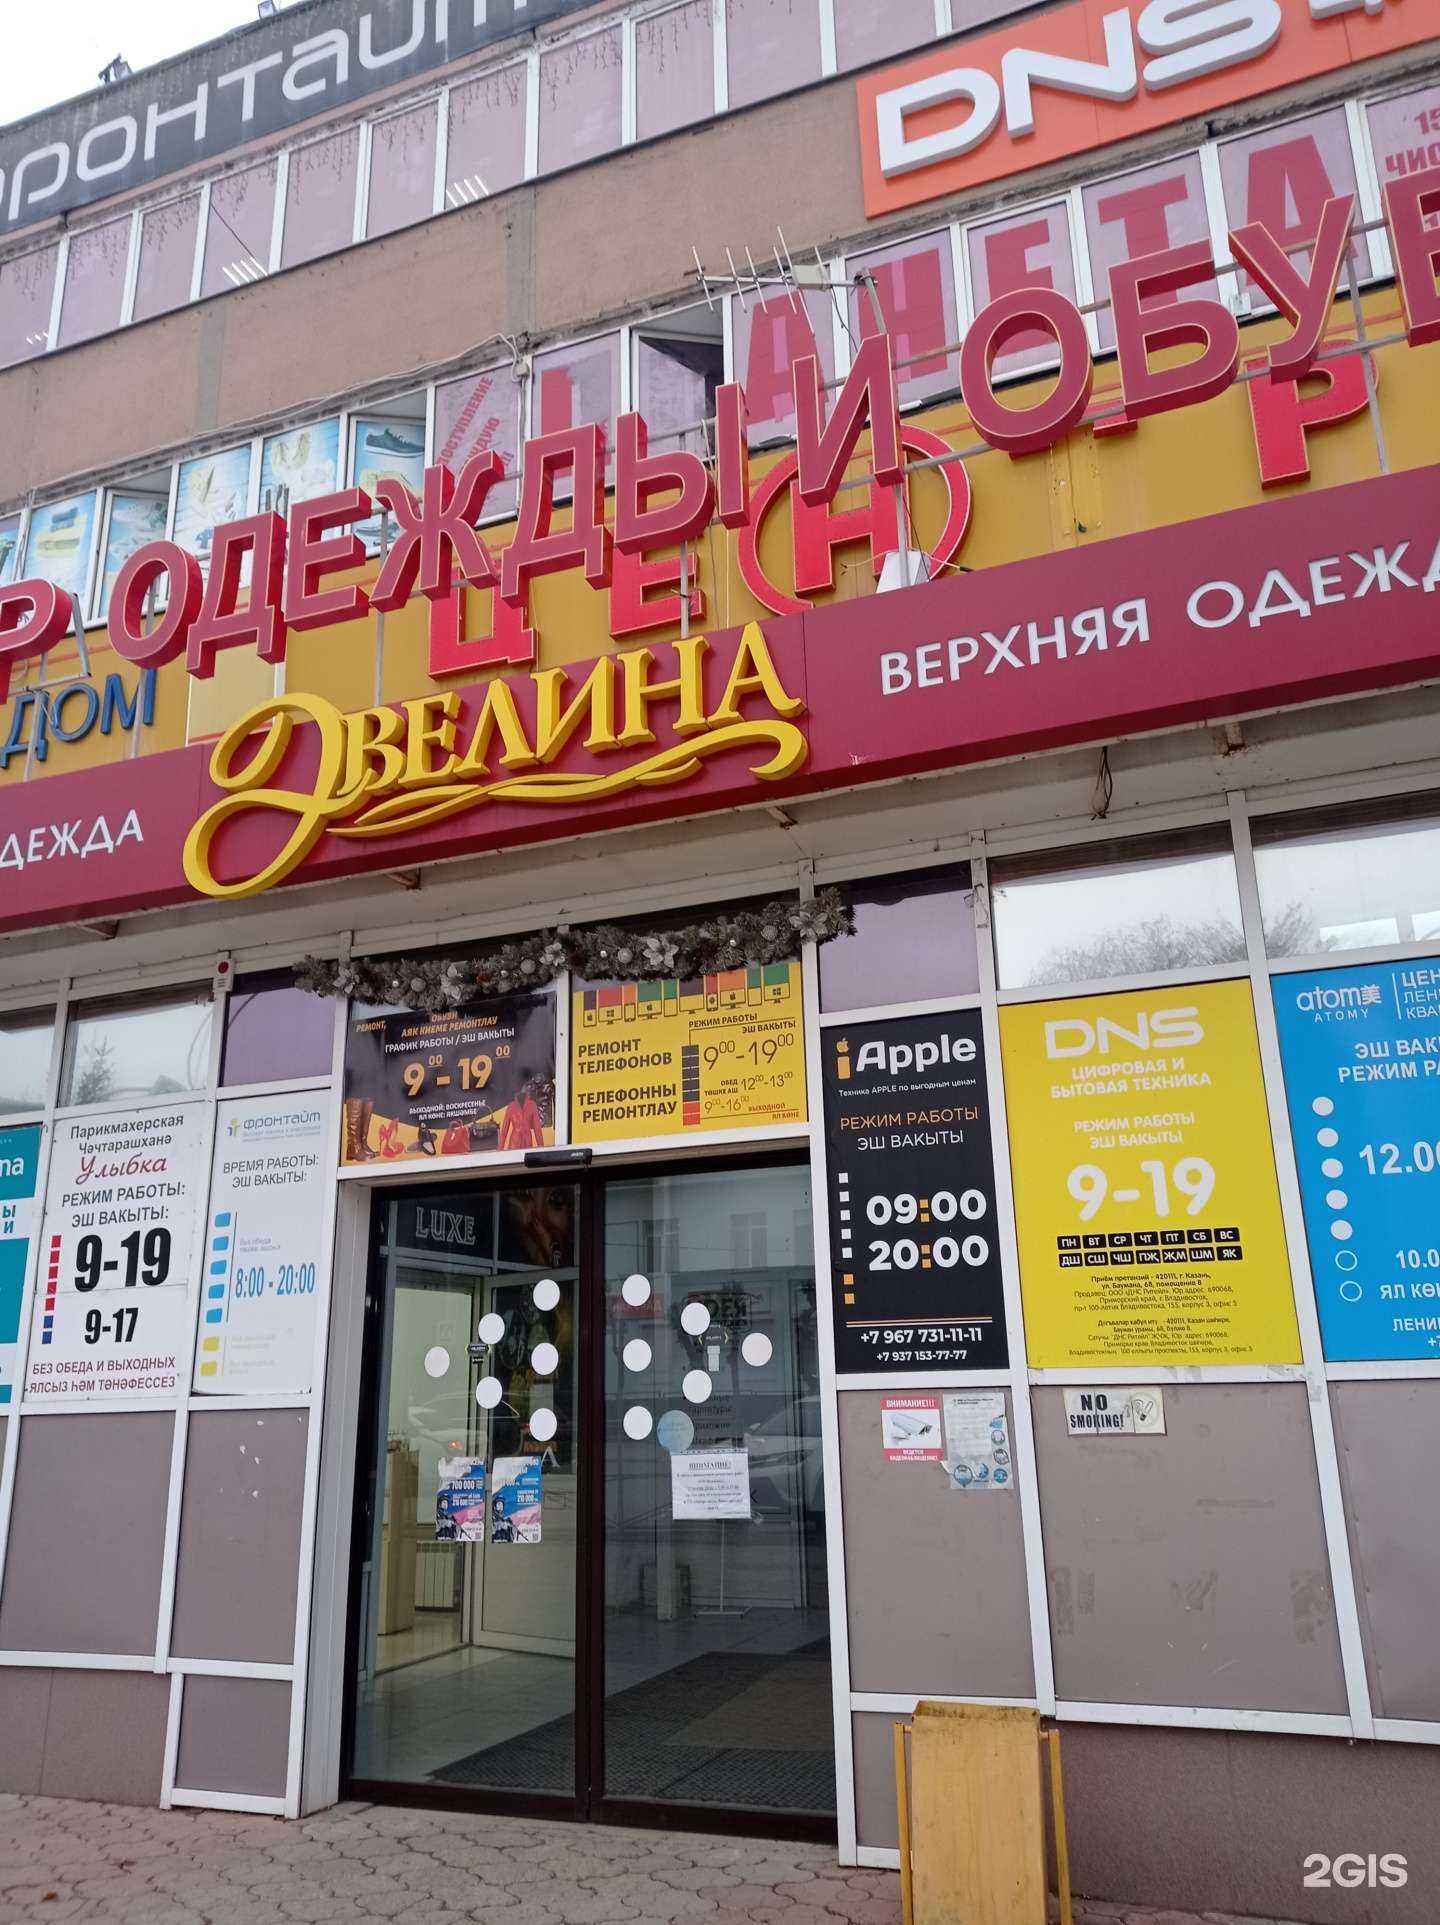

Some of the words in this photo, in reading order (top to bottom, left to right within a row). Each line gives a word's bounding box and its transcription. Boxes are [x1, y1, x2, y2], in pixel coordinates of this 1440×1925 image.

[876, 0, 1281, 179] DNS
[108, 382, 749, 679] ОДЕЖДЫ
[793, 333, 905, 507] И
[880, 598, 1150, 696] ВЕРХНЯЯ
[356, 1020, 387, 1033] РЕМОНТ,
[401, 1027, 418, 1037] АЯК
[449, 1016, 498, 1031] РЕМОНТЛАУ
[689, 1017, 721, 1028] РЕЖИМ
[721, 1013, 758, 1024] РАБОТЫ
[1314, 1009, 1370, 1023] ATOMY
[742, 1026, 756, 1034] ЭШ
[757, 1021, 796, 1032] ВАКЫТЫ
[1044, 1007, 1204, 1060] DNS
[385, 1041, 418, 1053] ГРАФИК
[420, 1035, 454, 1048] РАБОТЫ
[461, 1033, 476, 1044] ЭШ
[478, 1028, 515, 1042] ВАКЫТЫ
[578, 1038, 641, 1058] РЕМОНТ
[1354, 1041, 1389, 1059] ЭШ
[1395, 1036, 1440, 1056] ВАК
[578, 1052, 672, 1074] ТЕЛЕФОНОВ
[1072, 1060, 1165, 1081] ЦИФРОВАЯ
[1172, 1057, 1185, 1070] И
[1339, 1061, 1417, 1083] РЕЖИМ
[720, 1079, 738, 1087] ОБЕД
[727, 1087, 738, 1095] АШ
[838, 1089, 870, 1097] Техника
[871, 1085, 897, 1094] APPLE
[910, 1082, 950, 1091] выгодным
[952, 1079, 976, 1087] ценам
[1051, 1079, 1128, 1099] БЫТОВАЯ
[1133, 1073, 1212, 1091] ТЕХНИКА
[578, 1084, 677, 1106] ТЕЛЕФОННЫ
[582, 1101, 678, 1123] РЕМОНТЛАУ
[840, 1113, 901, 1131] РЕЖИМ
[907, 1106, 979, 1125] РАБОТЫ
[1074, 1117, 1129, 1133] РЕЖИМ
[1133, 1112, 1195, 1129] РАБОТЫ
[71, 1115, 184, 1139] Парикмахерская
[857, 1136, 885, 1151] ЭШ
[891, 1130, 964, 1149] ВАКЫТЫ
[1090, 1135, 1115, 1149] ЭШ
[1120, 1131, 1183, 1147] ВАКЫТЫ
[76, 1155, 167, 1185] Улыбка
[223, 1159, 264, 1174] ВРЕМЯ
[267, 1154, 319, 1169] РАБОТЫ:
[232, 1177, 251, 1188] ЭШ
[255, 1171, 307, 1186] ВАКЫТЫ:
[1066, 1157, 1216, 1222] 9-19
[62, 1187, 112, 1207] РЕЖИМ
[117, 1181, 186, 1201] РАБОТЫ:
[72, 1212, 93, 1228] ЭШ
[99, 1206, 169, 1226] ВАКЫТЫ:
[866, 1189, 987, 1226] 09:00
[415, 1206, 476, 1246] LUXE
[1062, 1237, 1077, 1249] ПН
[1088, 1235, 1101, 1247] ВТ
[1113, 1234, 1127, 1246] СР
[1139, 1234, 1153, 1245] ЧТ
[1165, 1233, 1179, 1244] ПТ
[1192, 1231, 1207, 1242] СБ
[1220, 1229, 1234, 1240] ВС
[74, 1227, 171, 1292] 9-19
[868, 1235, 989, 1271] 20:00
[1061, 1255, 1081, 1267] ДШ
[1087, 1253, 1106, 1264] СШ
[1113, 1252, 1132, 1264] ЧШ
[1191, 1249, 1213, 1260] ШМ
[1222, 1249, 1237, 1259] ЯК
[235, 1267, 265, 1298] 8:00
[276, 1262, 316, 1295] 20:00
[1186, 1272, 1211, 1280] Казань,
[1380, 1284, 1405, 1299] ЯЛ
[84, 1307, 138, 1344] 9-17
[860, 1330, 880, 1344] +7
[883, 1329, 914, 1344] 967
[918, 1327, 982, 1343] 731-11-11
[33, 1363, 53, 1375] БЕЗ
[56, 1361, 93, 1374] ОБЕДА
[96, 1361, 104, 1371] И
[108, 1356, 175, 1371] ВЫХОДНЫХ
[876, 1351, 889, 1361] +7
[891, 1350, 913, 1361] 937
[915, 1349, 967, 1361] 153-77-77
[29, 1380, 67, 1394] ЯЛСЫЗ
[98, 1376, 175, 1391] ТӘНӘФЕССЕЗ
[1081, 1393, 1108, 1411] NO
[1070, 1413, 1124, 1430] SMOKING!
